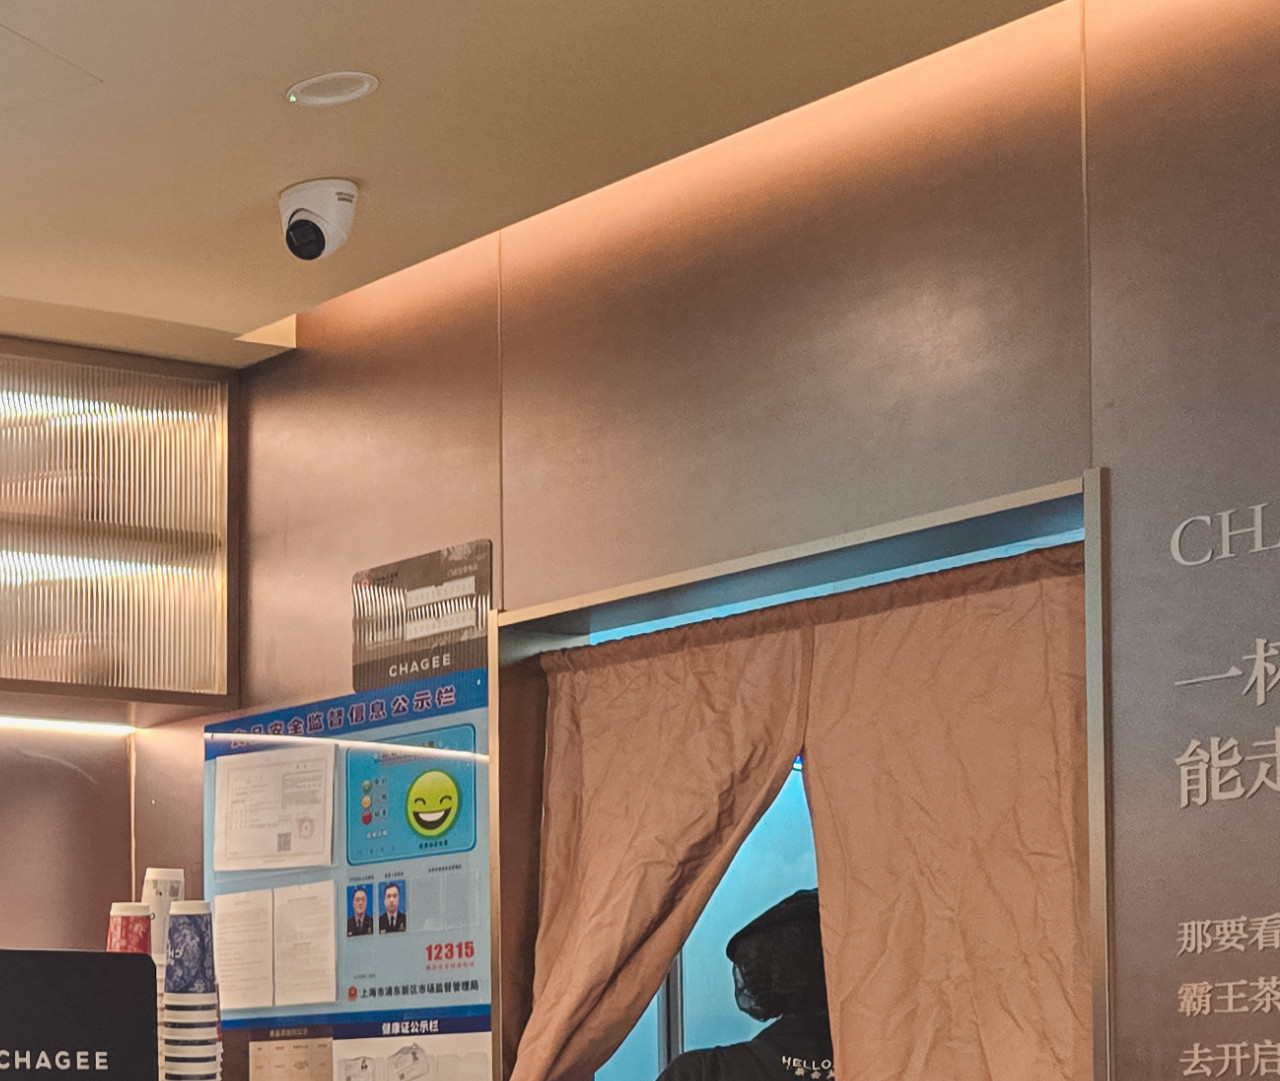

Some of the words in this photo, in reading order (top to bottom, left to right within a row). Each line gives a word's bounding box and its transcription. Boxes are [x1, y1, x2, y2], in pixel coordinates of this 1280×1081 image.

[1169, 503, 1280, 567] CH
[389, 653, 451, 677] CHAGEE
[1177, 912, 1280, 956] 那要看
[425, 940, 475, 961] 12315
[360, 979, 479, 999] 上海市浦东新区市场监督管理局
[1177, 977, 1280, 1018] 霸王茶
[382, 1019, 440, 1036] 健康证公示栏
[1178, 1038, 1280, 1079] 去开启
